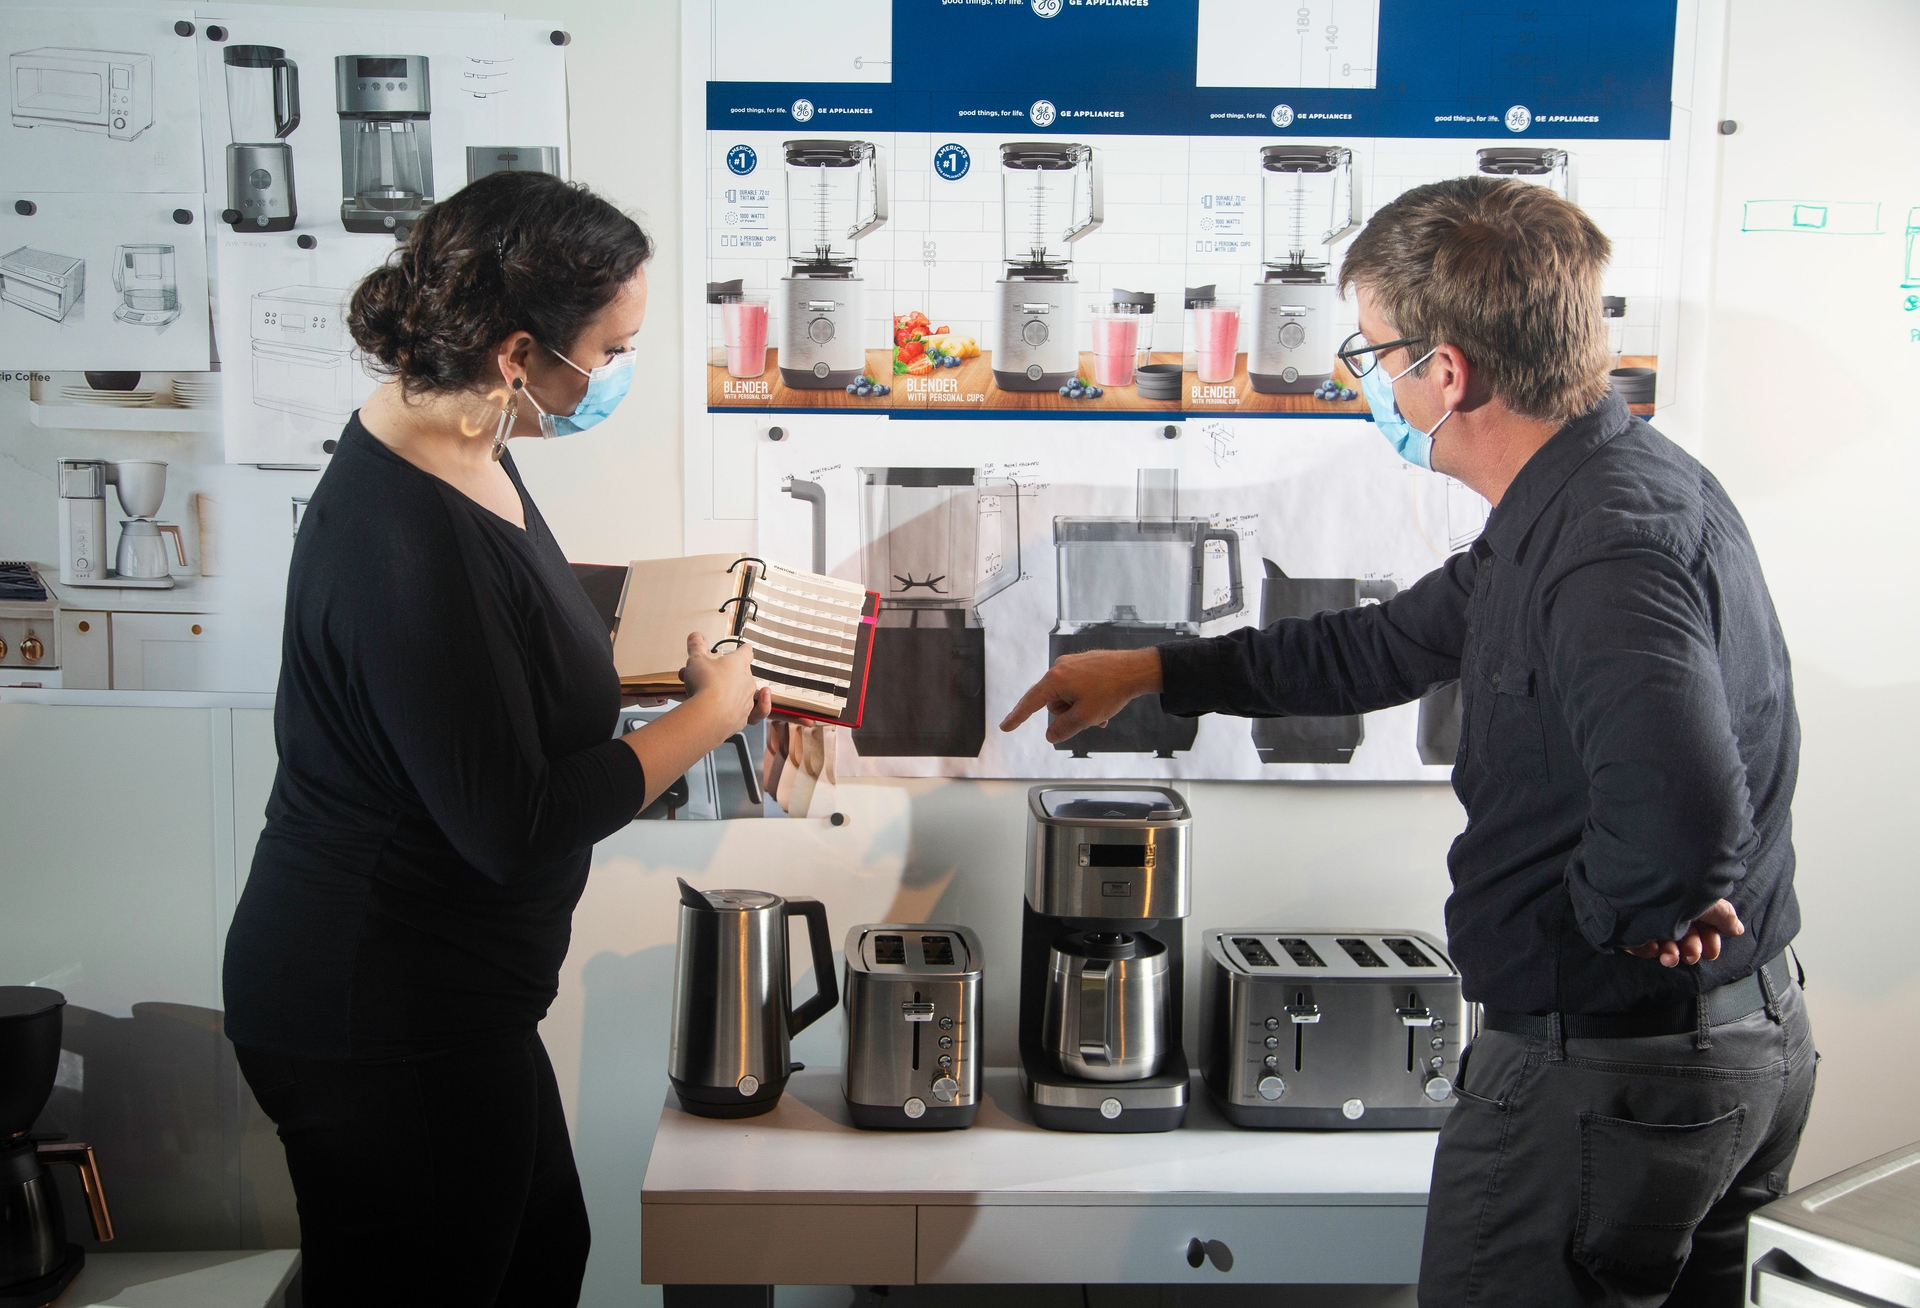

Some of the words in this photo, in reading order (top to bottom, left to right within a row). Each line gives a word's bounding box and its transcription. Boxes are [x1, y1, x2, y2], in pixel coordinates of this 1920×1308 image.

[938, 145, 968, 159] AMERICA'S
[734, 152, 746, 169] #1
[942, 153, 956, 172] #1
[15, 373, 50, 381] Coffee
[724, 381, 768, 393] BLENDER
[906, 378, 957, 392] BLENDER
[1192, 386, 1236, 398] BLENDER
